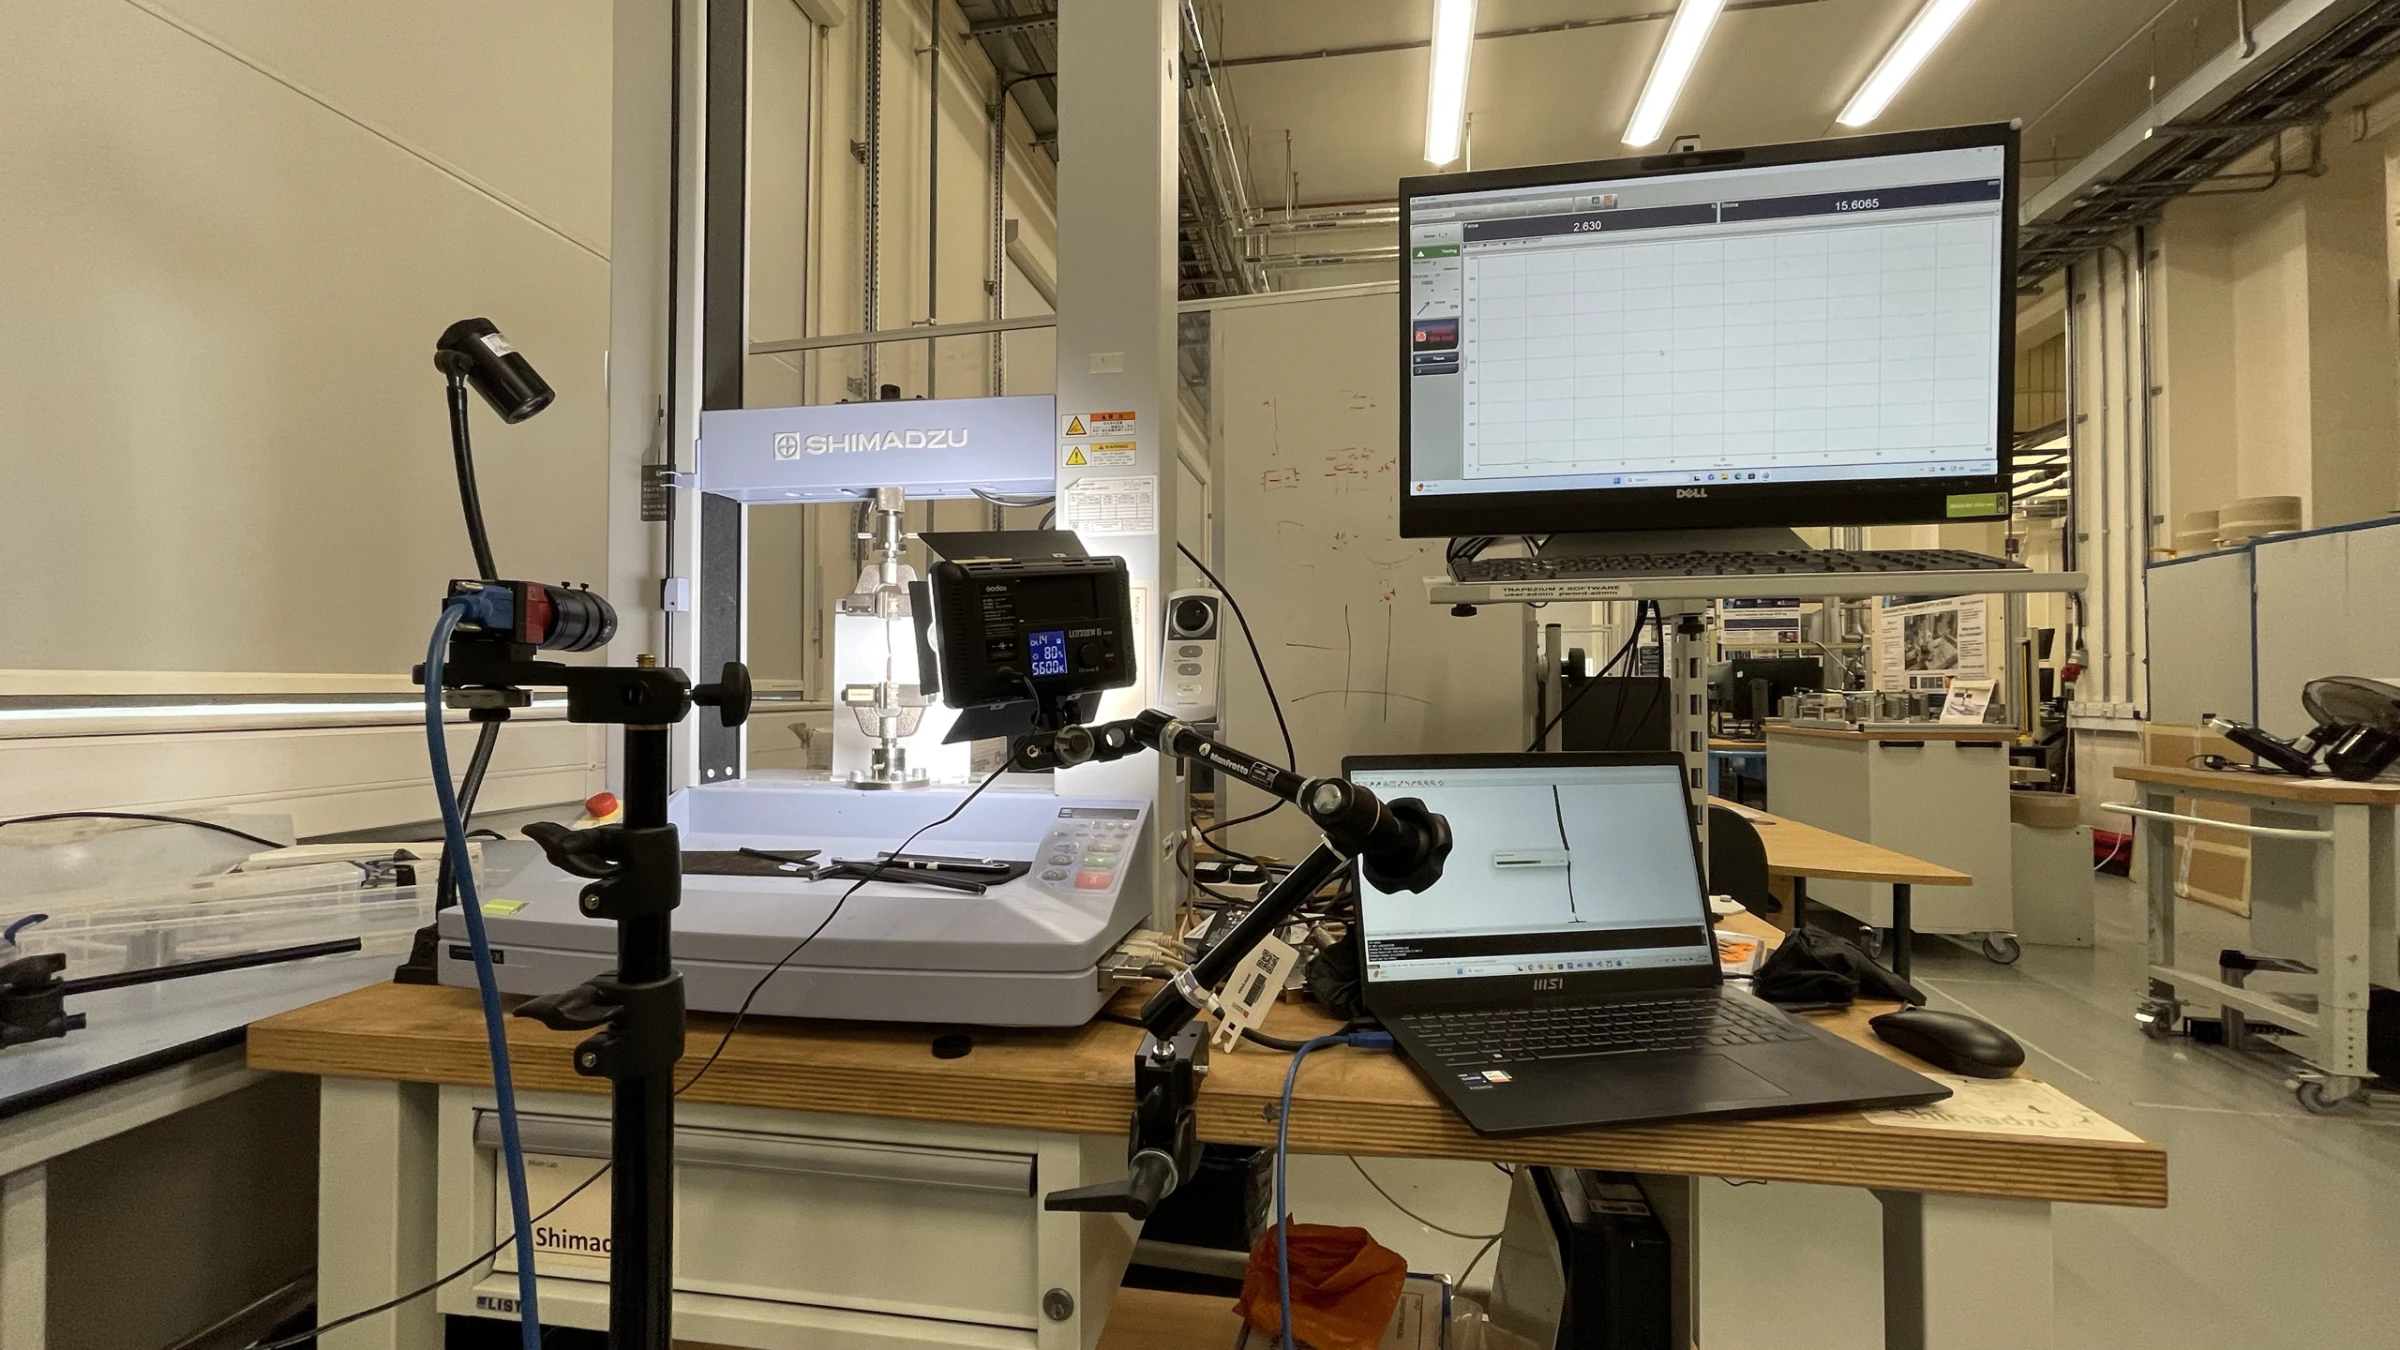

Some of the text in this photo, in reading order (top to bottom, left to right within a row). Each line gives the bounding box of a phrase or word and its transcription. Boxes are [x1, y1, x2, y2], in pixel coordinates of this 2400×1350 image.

[1835, 198, 1880, 211] 15.6065
[1573, 220, 1602, 232] 2.630
[804, 428, 969, 455] SHIMADZU
[1676, 487, 1708, 499] DELL
[1032, 660, 1065, 676] 5600K
[1210, 752, 1249, 775] Manfrotto
[487, 1298, 521, 1313] LIST
